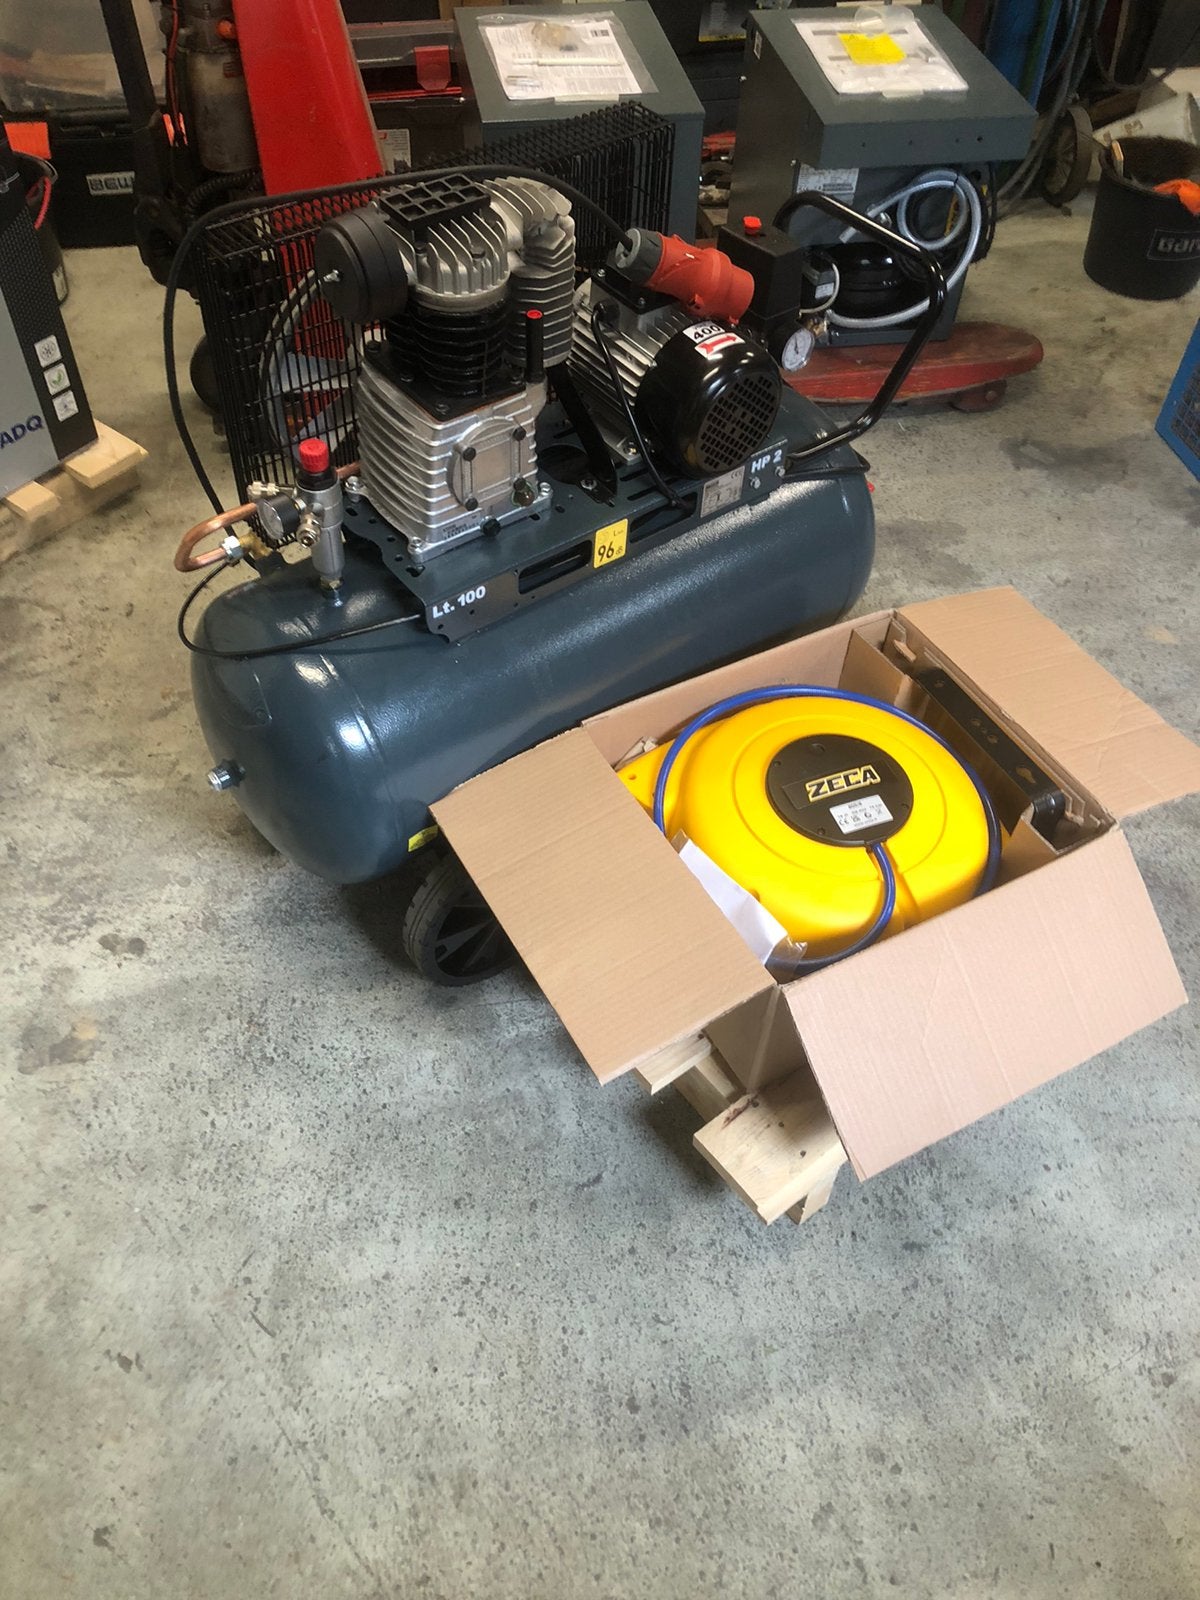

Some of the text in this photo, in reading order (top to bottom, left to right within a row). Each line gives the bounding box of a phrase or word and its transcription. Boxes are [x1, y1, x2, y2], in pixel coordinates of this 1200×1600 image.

[693, 325, 721, 340] 400
[751, 449, 782, 473] HP 2
[597, 540, 615, 562] 96
[432, 585, 487, 619] Lt. 100
[805, 764, 881, 803] ZECA
